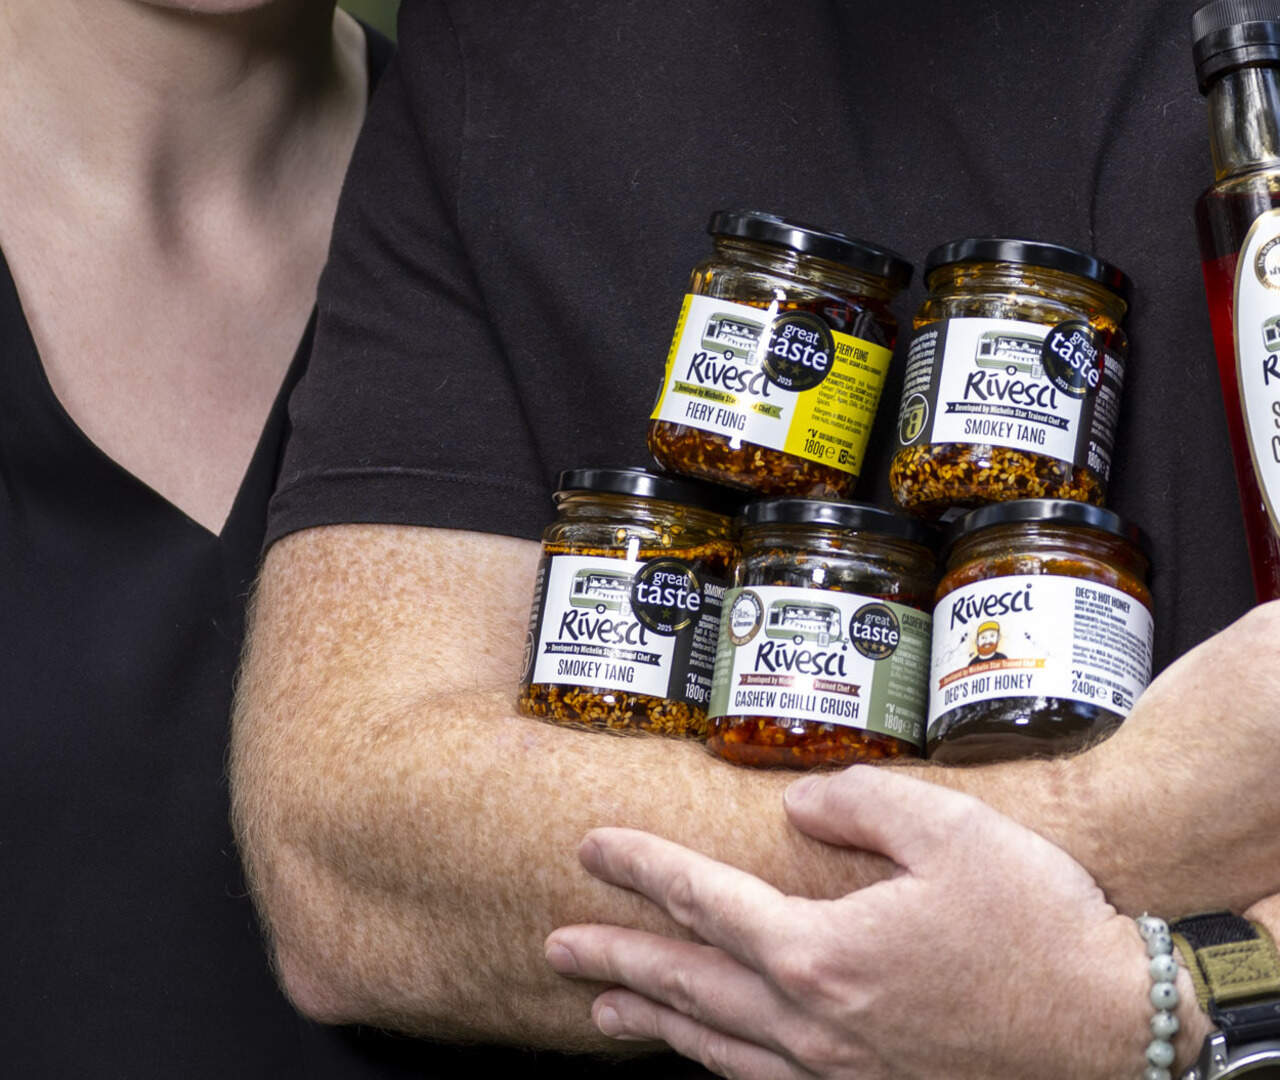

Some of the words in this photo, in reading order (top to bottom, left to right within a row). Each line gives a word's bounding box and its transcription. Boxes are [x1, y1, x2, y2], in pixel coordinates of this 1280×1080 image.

[782, 323, 820, 345] great
[1070, 331, 1098, 361] great
[767, 332, 828, 371] taste
[1050, 332, 1100, 388] taste
[686, 401, 714, 422] FIERY
[715, 407, 747, 431] FUNG
[964, 418, 1014, 439] SMOKEY
[1017, 423, 1046, 445] TANG
[804, 437, 825, 458] 180g
[653, 571, 689, 586] great
[636, 581, 701, 612] taste
[1098, 591, 1110, 605] HOT
[864, 613, 890, 626] great
[852, 621, 899, 646] taste
[558, 659, 601, 679] SMOKEY
[604, 663, 635, 683] TANG
[685, 683, 705, 703] 180g
[944, 681, 969, 705] DEC'S
[971, 676, 991, 695] HOT
[994, 673, 1033, 690] HONEY
[1071, 679, 1095, 698] 240g
[735, 690, 777, 708] CASHEW
[780, 692, 816, 712] CHILLI
[820, 696, 860, 719] CRUSH
